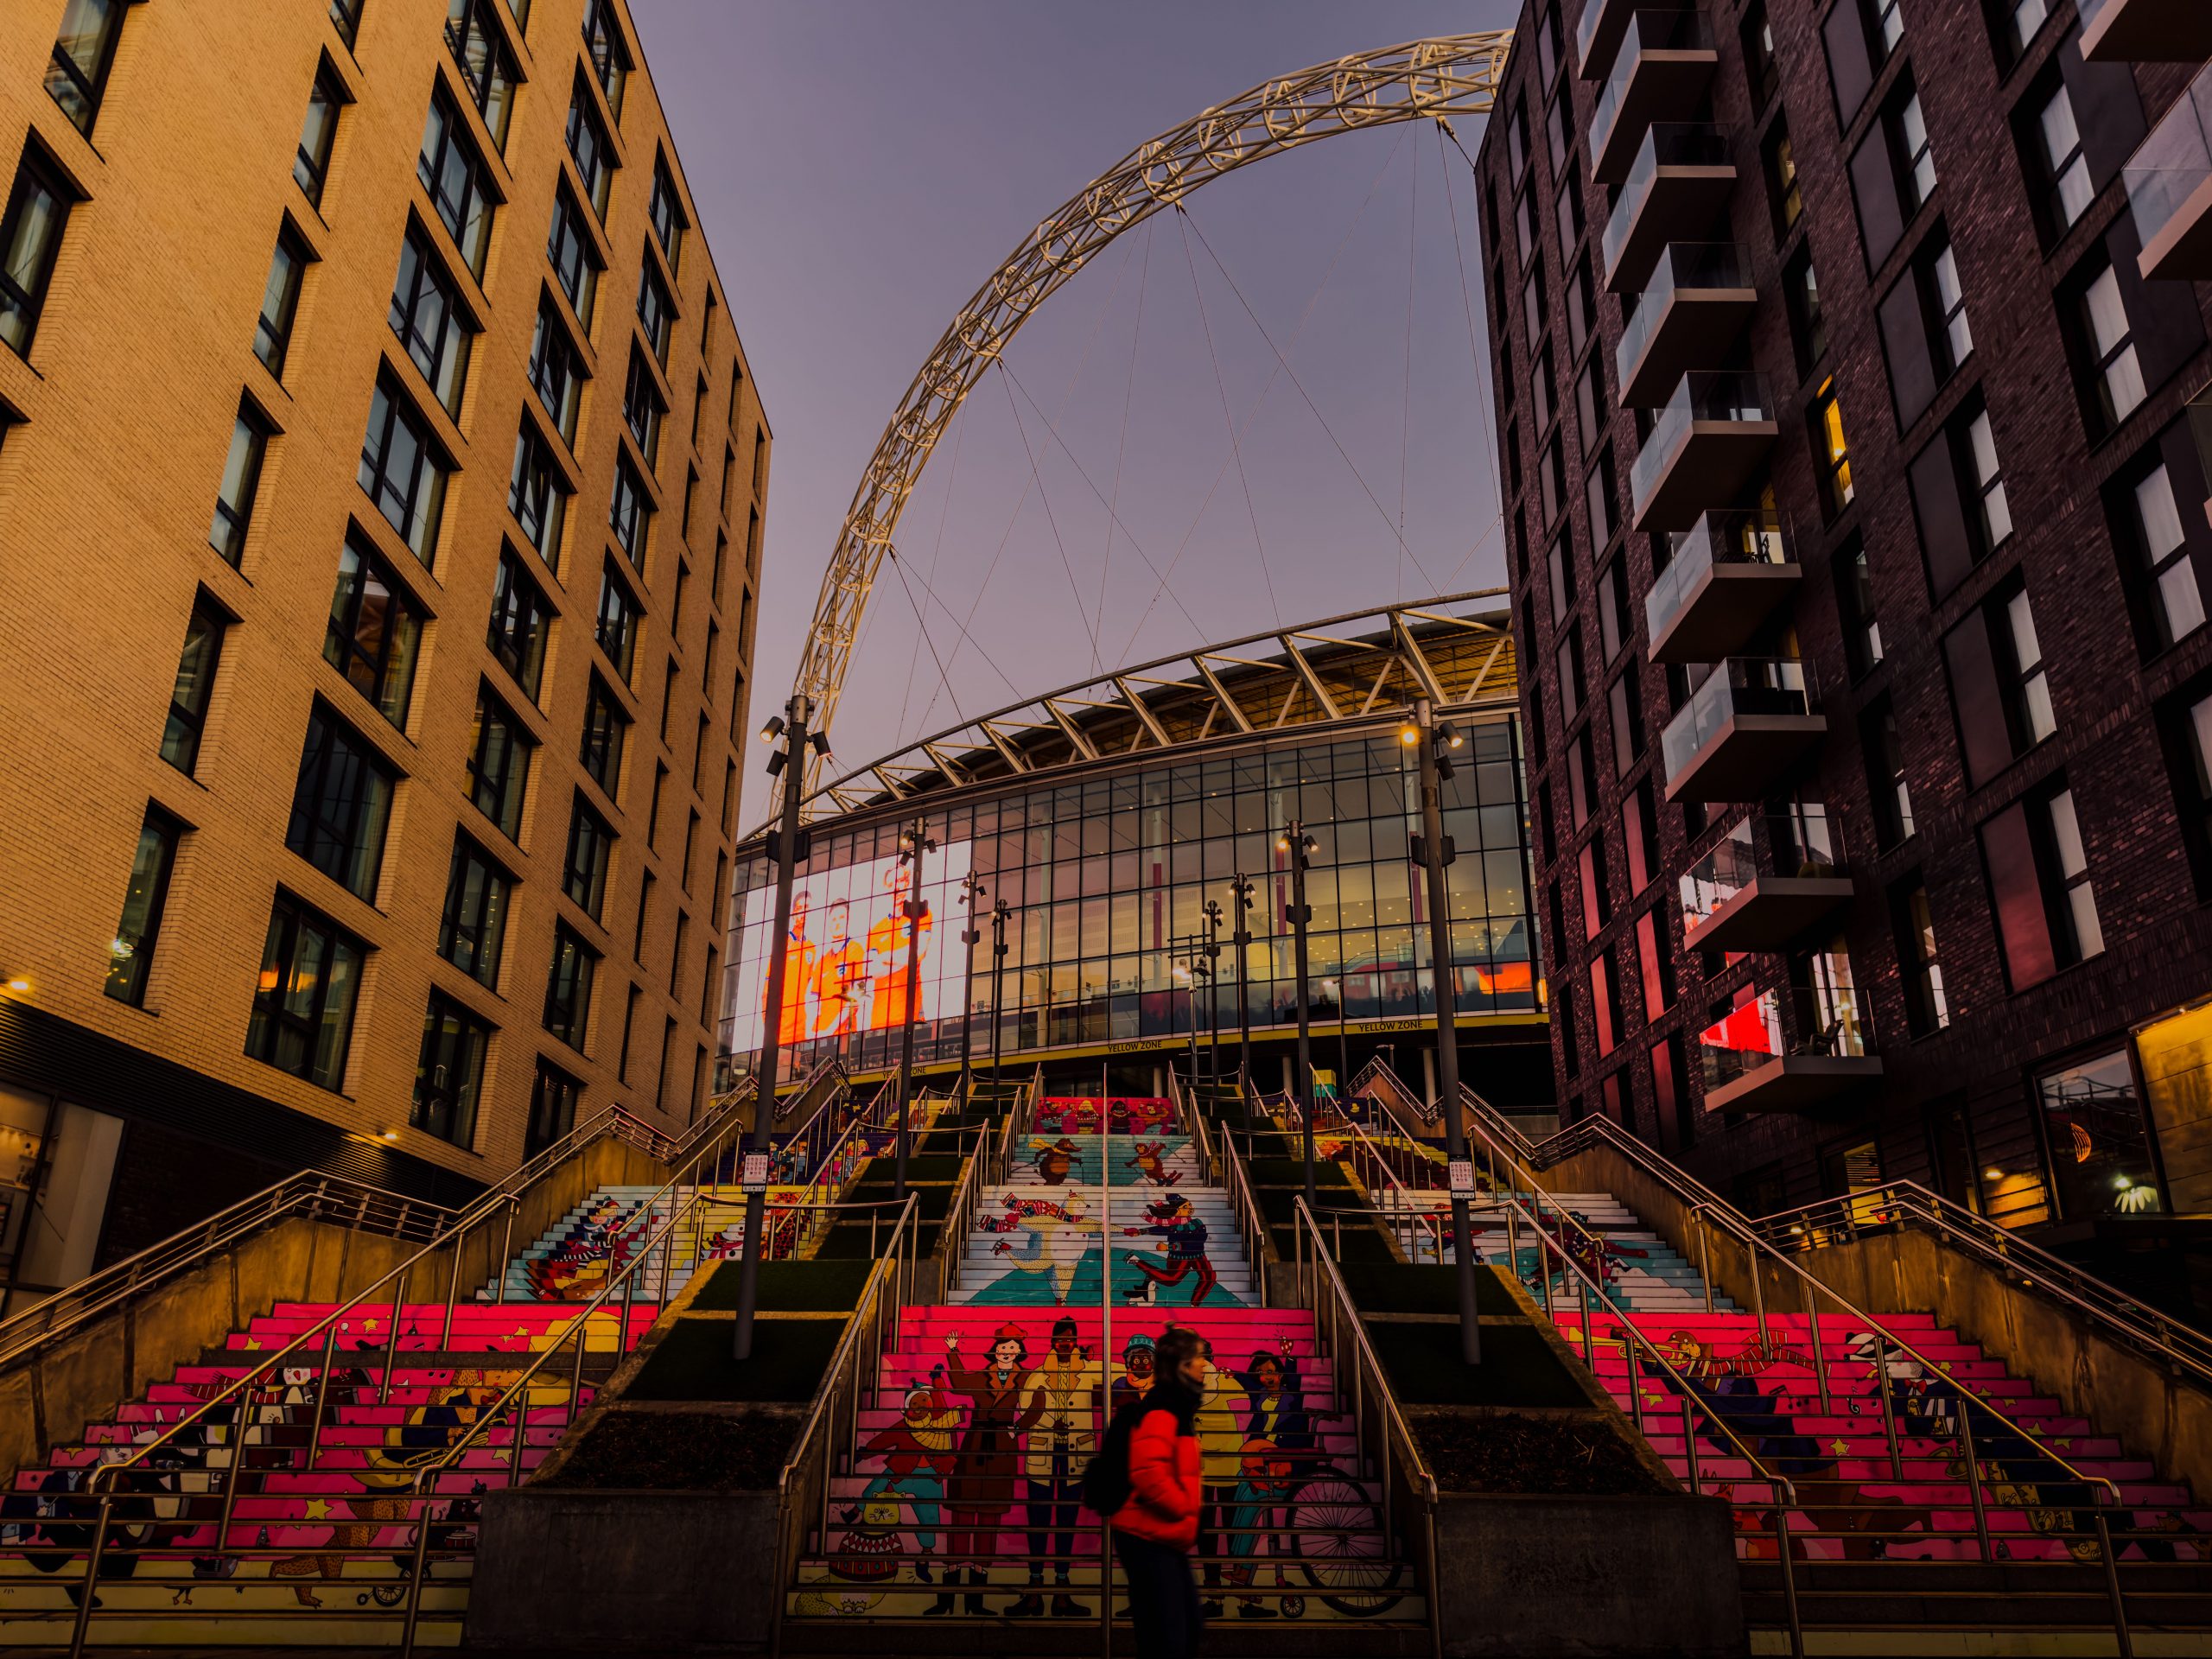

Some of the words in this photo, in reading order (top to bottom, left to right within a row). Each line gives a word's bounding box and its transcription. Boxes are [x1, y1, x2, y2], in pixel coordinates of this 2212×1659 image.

[1359, 1023, 1395, 1032] YELLOW
[1398, 1020, 1423, 1029] ZONE
[1108, 1043, 1139, 1052] YELLOW
[1141, 1040, 1162, 1049] ZONE
